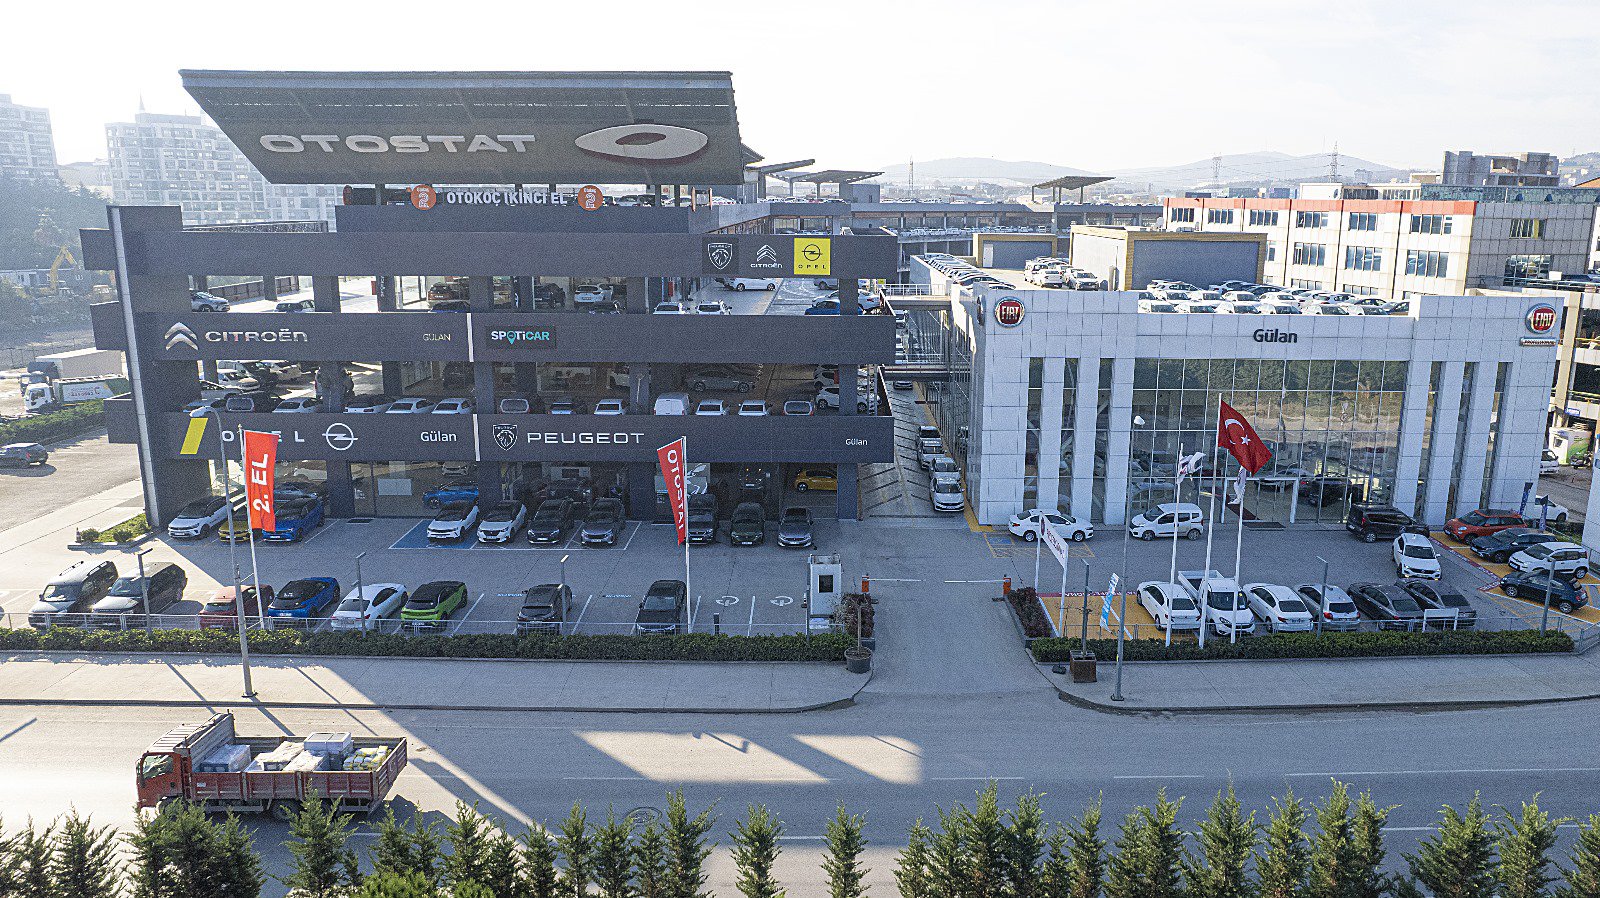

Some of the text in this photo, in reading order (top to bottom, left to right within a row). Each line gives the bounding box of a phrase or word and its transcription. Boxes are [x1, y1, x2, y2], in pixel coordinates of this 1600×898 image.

[259, 134, 536, 153] OTOSTAT
[551, 191, 568, 205] EL
[1001, 305, 1020, 320] FIAT
[1535, 312, 1553, 327] FIAT
[1252, 328, 1298, 343] Gülan
[420, 431, 457, 443] Gülan
[527, 432, 645, 444] PEUGEOT
[845, 437, 868, 446] Gülan
[251, 453, 269, 486] EL
